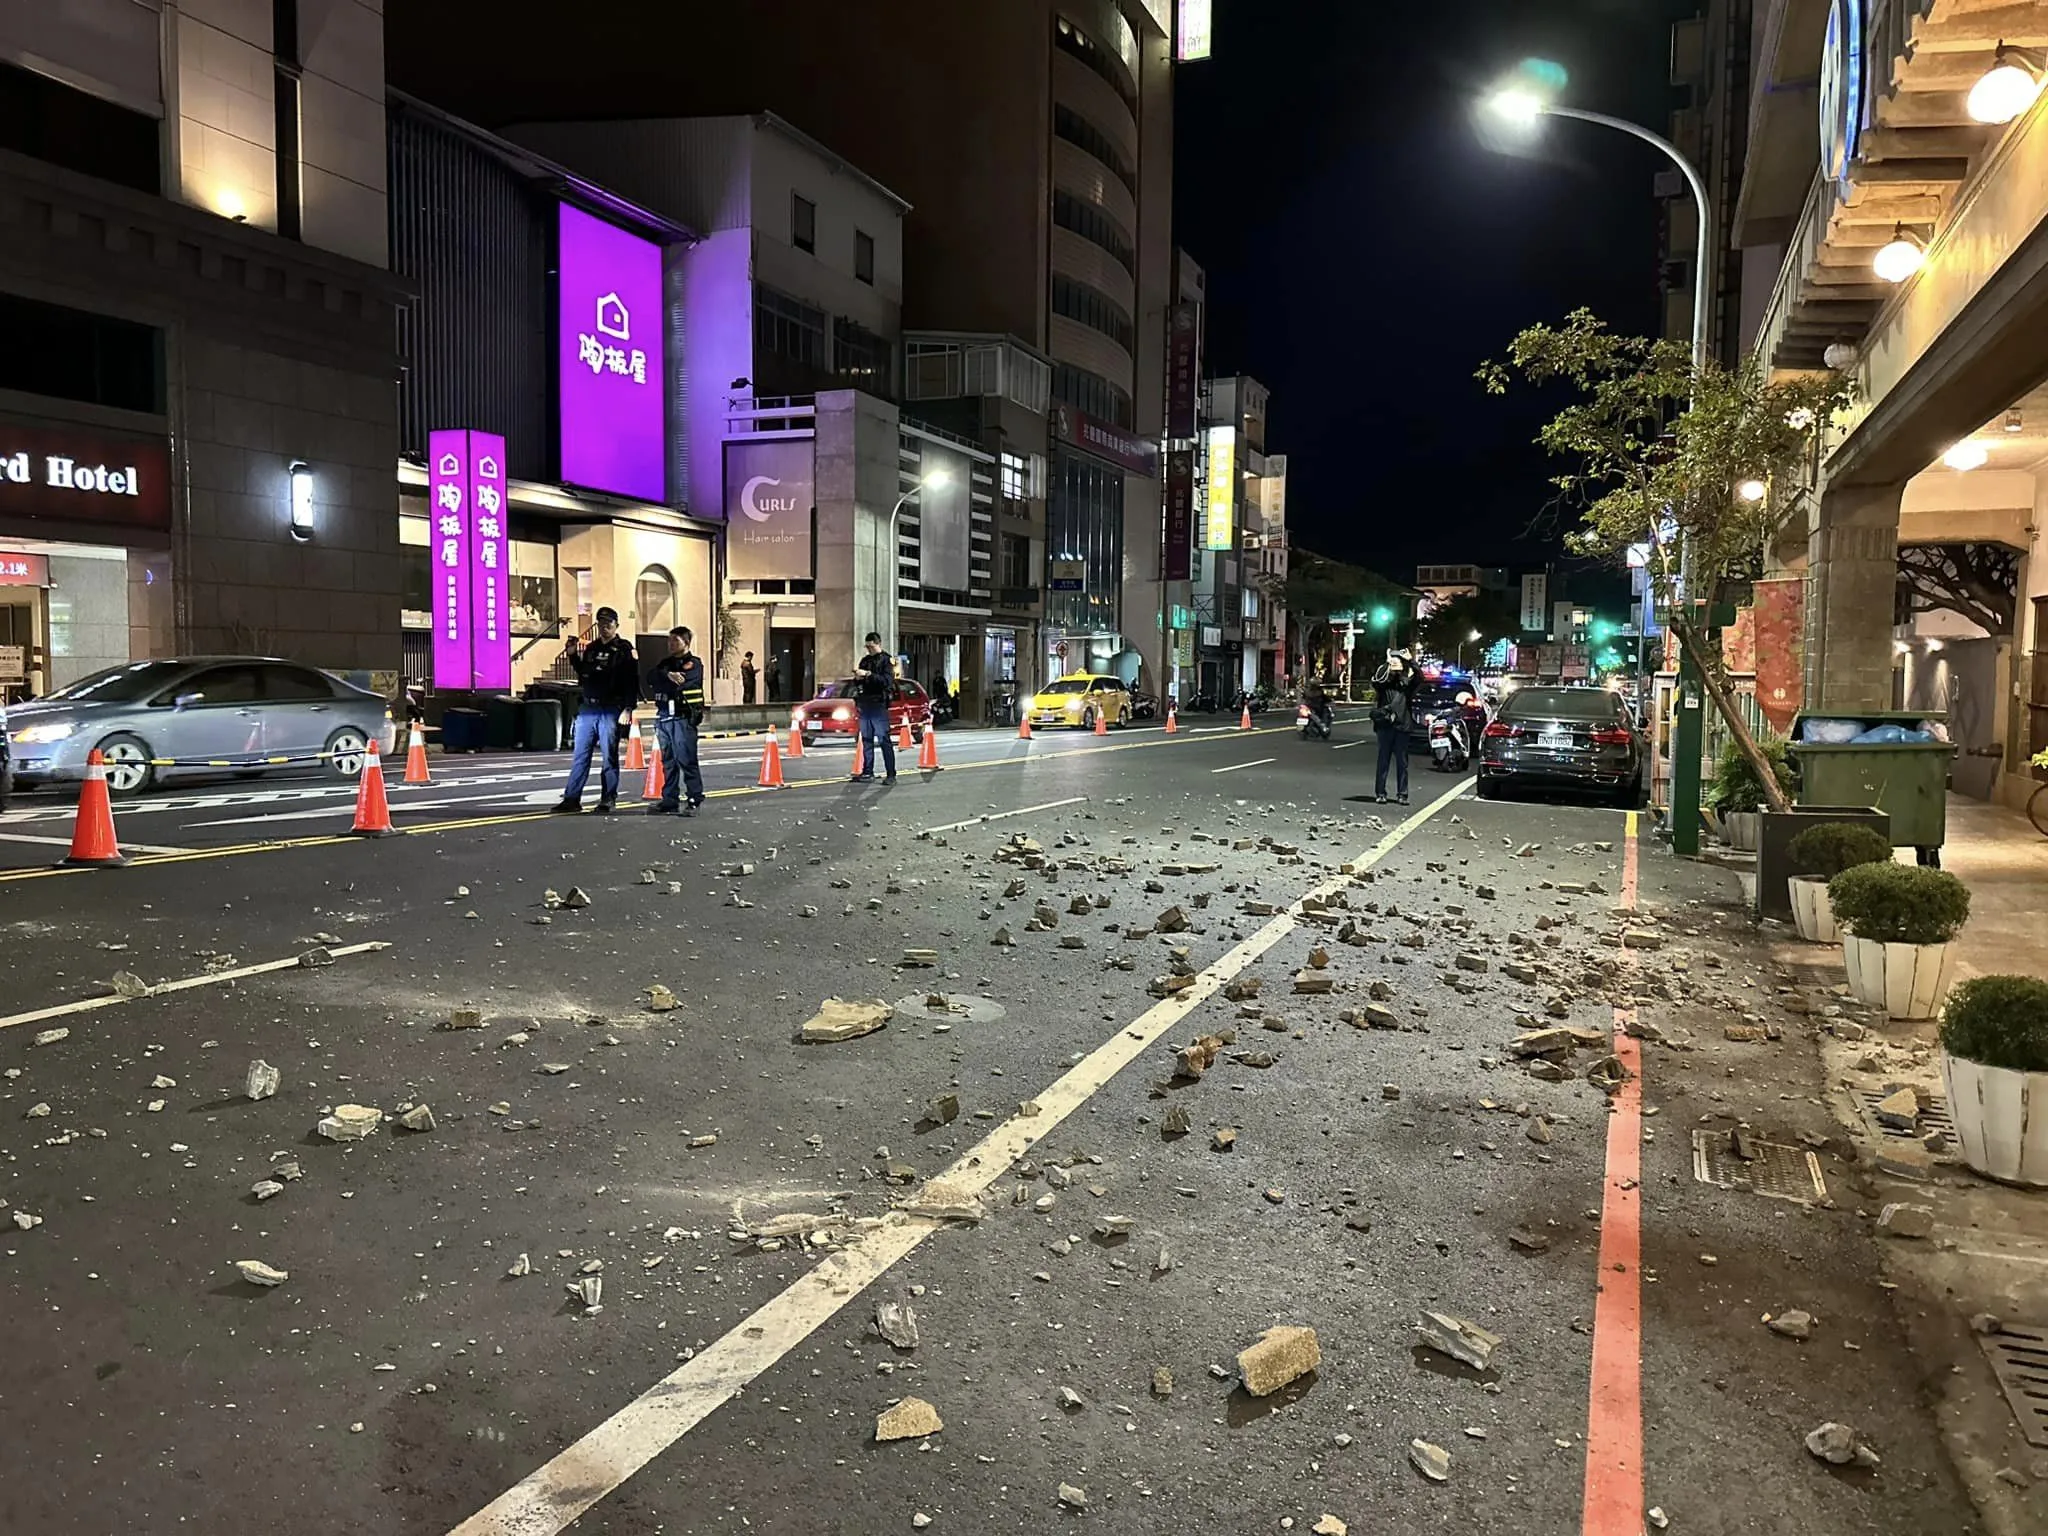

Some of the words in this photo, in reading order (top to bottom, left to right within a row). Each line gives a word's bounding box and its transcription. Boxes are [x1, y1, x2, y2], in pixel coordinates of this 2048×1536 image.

[578, 333, 647, 385] 陶板屋
[45, 455, 139, 495] Hotel
[437, 482, 463, 567] 陶板屋
[477, 484, 501, 569] 陶板屋
[744, 528, 769, 545] Hair
[771, 528, 796, 544] salon
